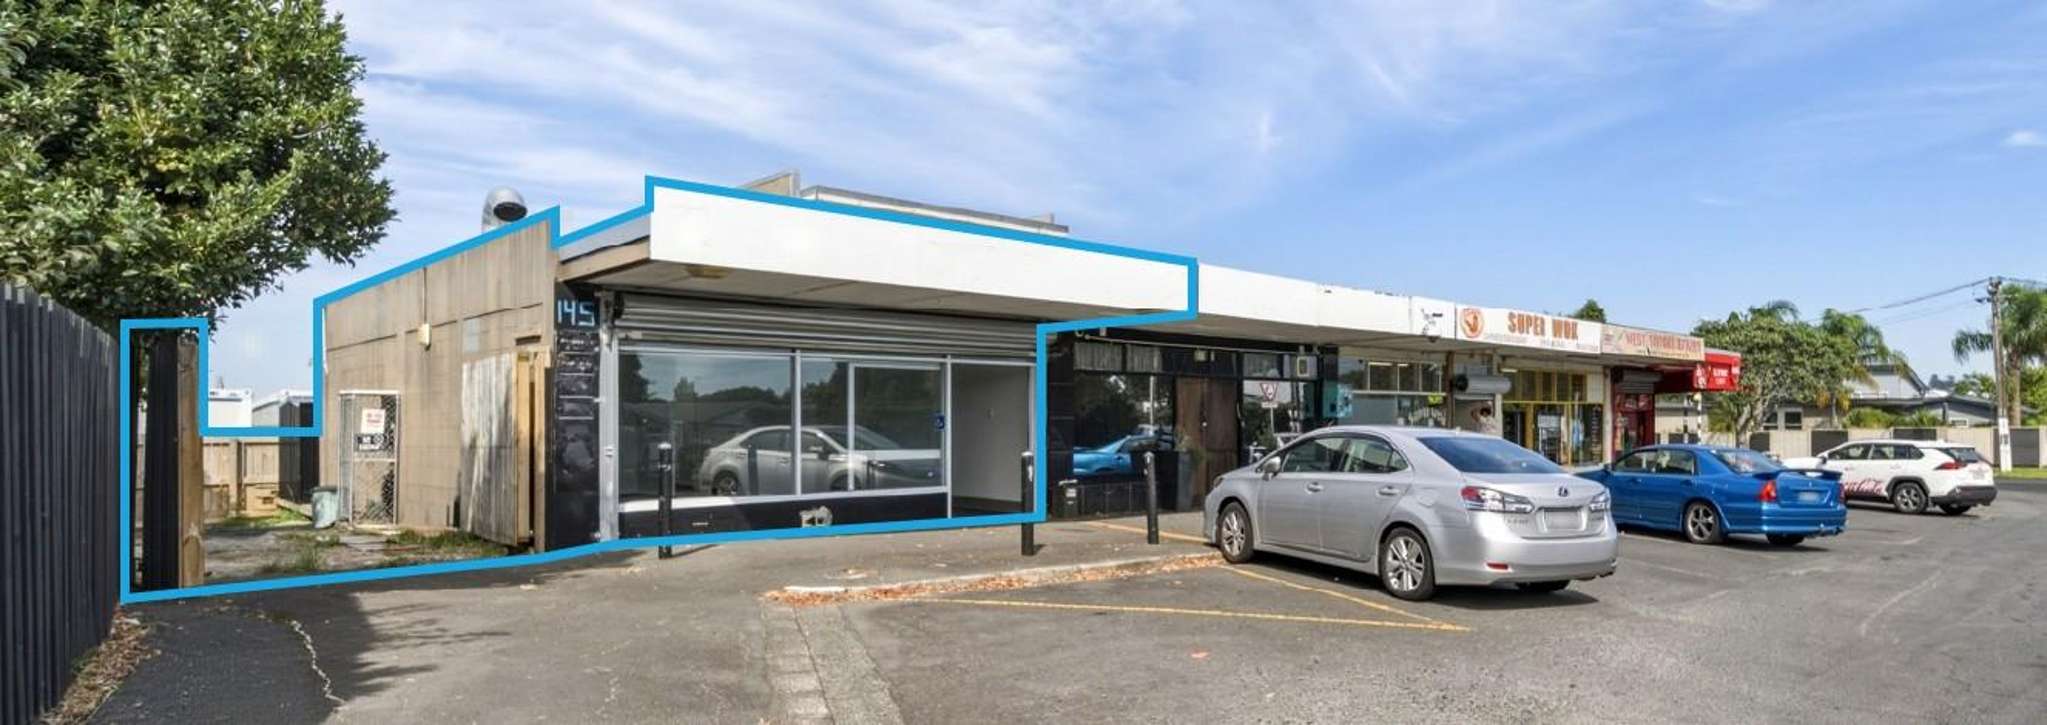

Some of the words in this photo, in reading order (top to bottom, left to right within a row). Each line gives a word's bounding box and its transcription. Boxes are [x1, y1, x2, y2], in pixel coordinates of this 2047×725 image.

[557, 299, 596, 326] 145
[1507, 311, 1545, 336] SUPER
[1552, 318, 1579, 340] WOK
